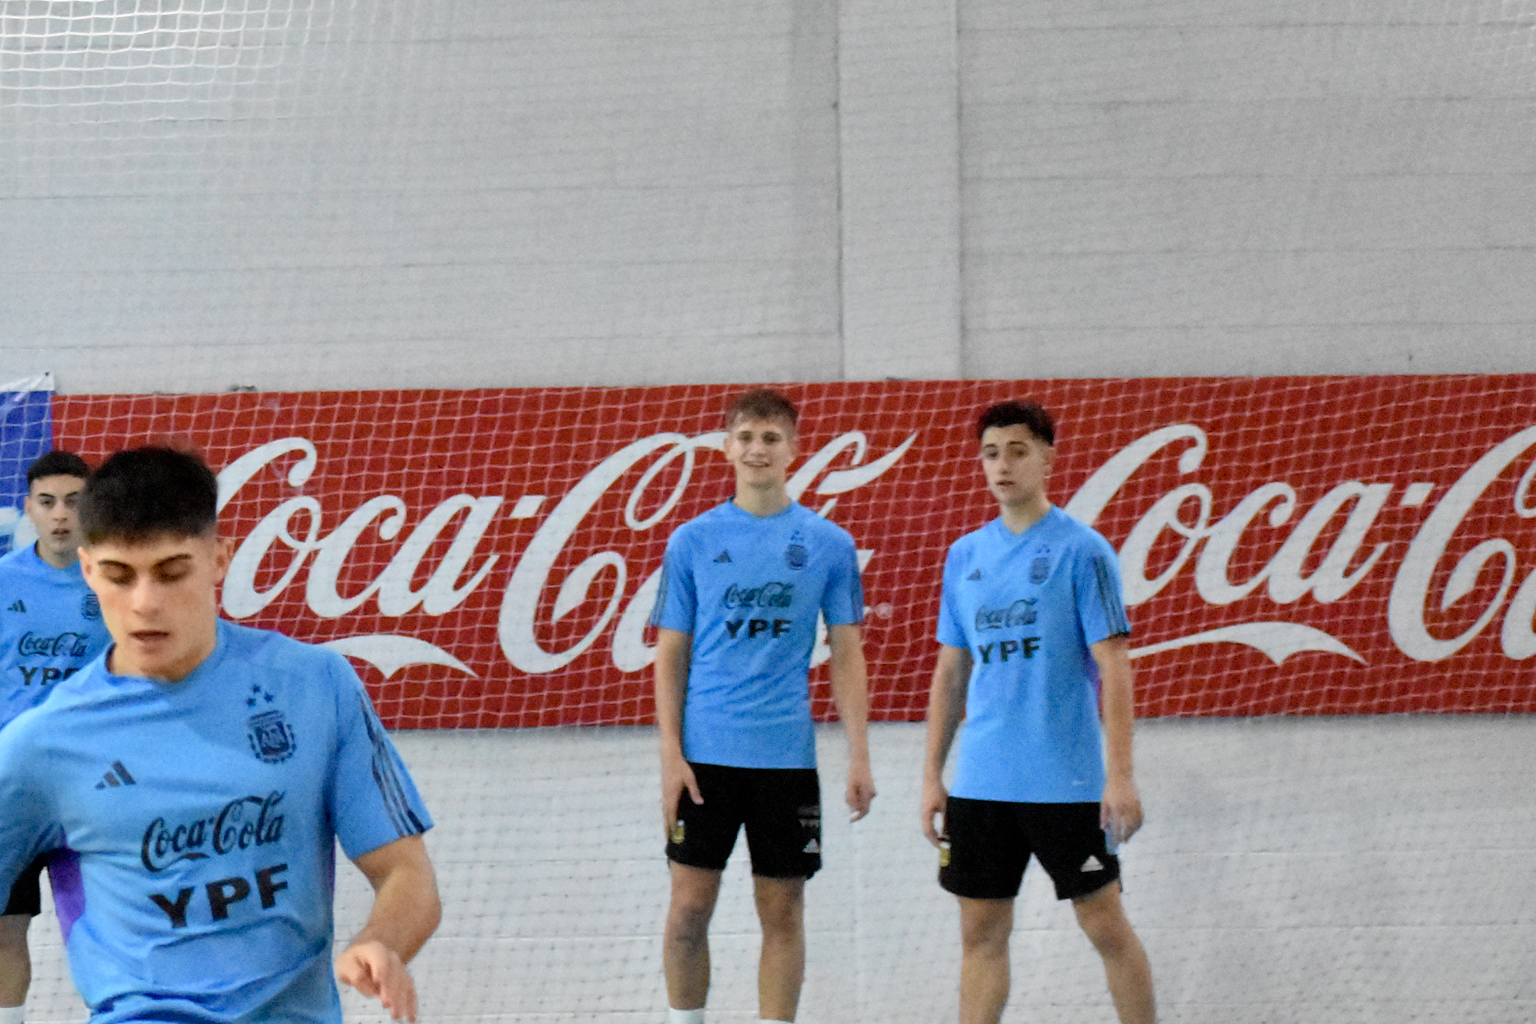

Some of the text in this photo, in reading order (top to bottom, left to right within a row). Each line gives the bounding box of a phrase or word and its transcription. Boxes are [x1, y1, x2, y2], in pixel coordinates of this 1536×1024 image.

[216, 430, 920, 676] Coca-C
[726, 618, 793, 639] YPF
[978, 636, 1042, 665] YPF
[140, 789, 286, 873] Coca-Cola
[149, 863, 288, 930] YPF
